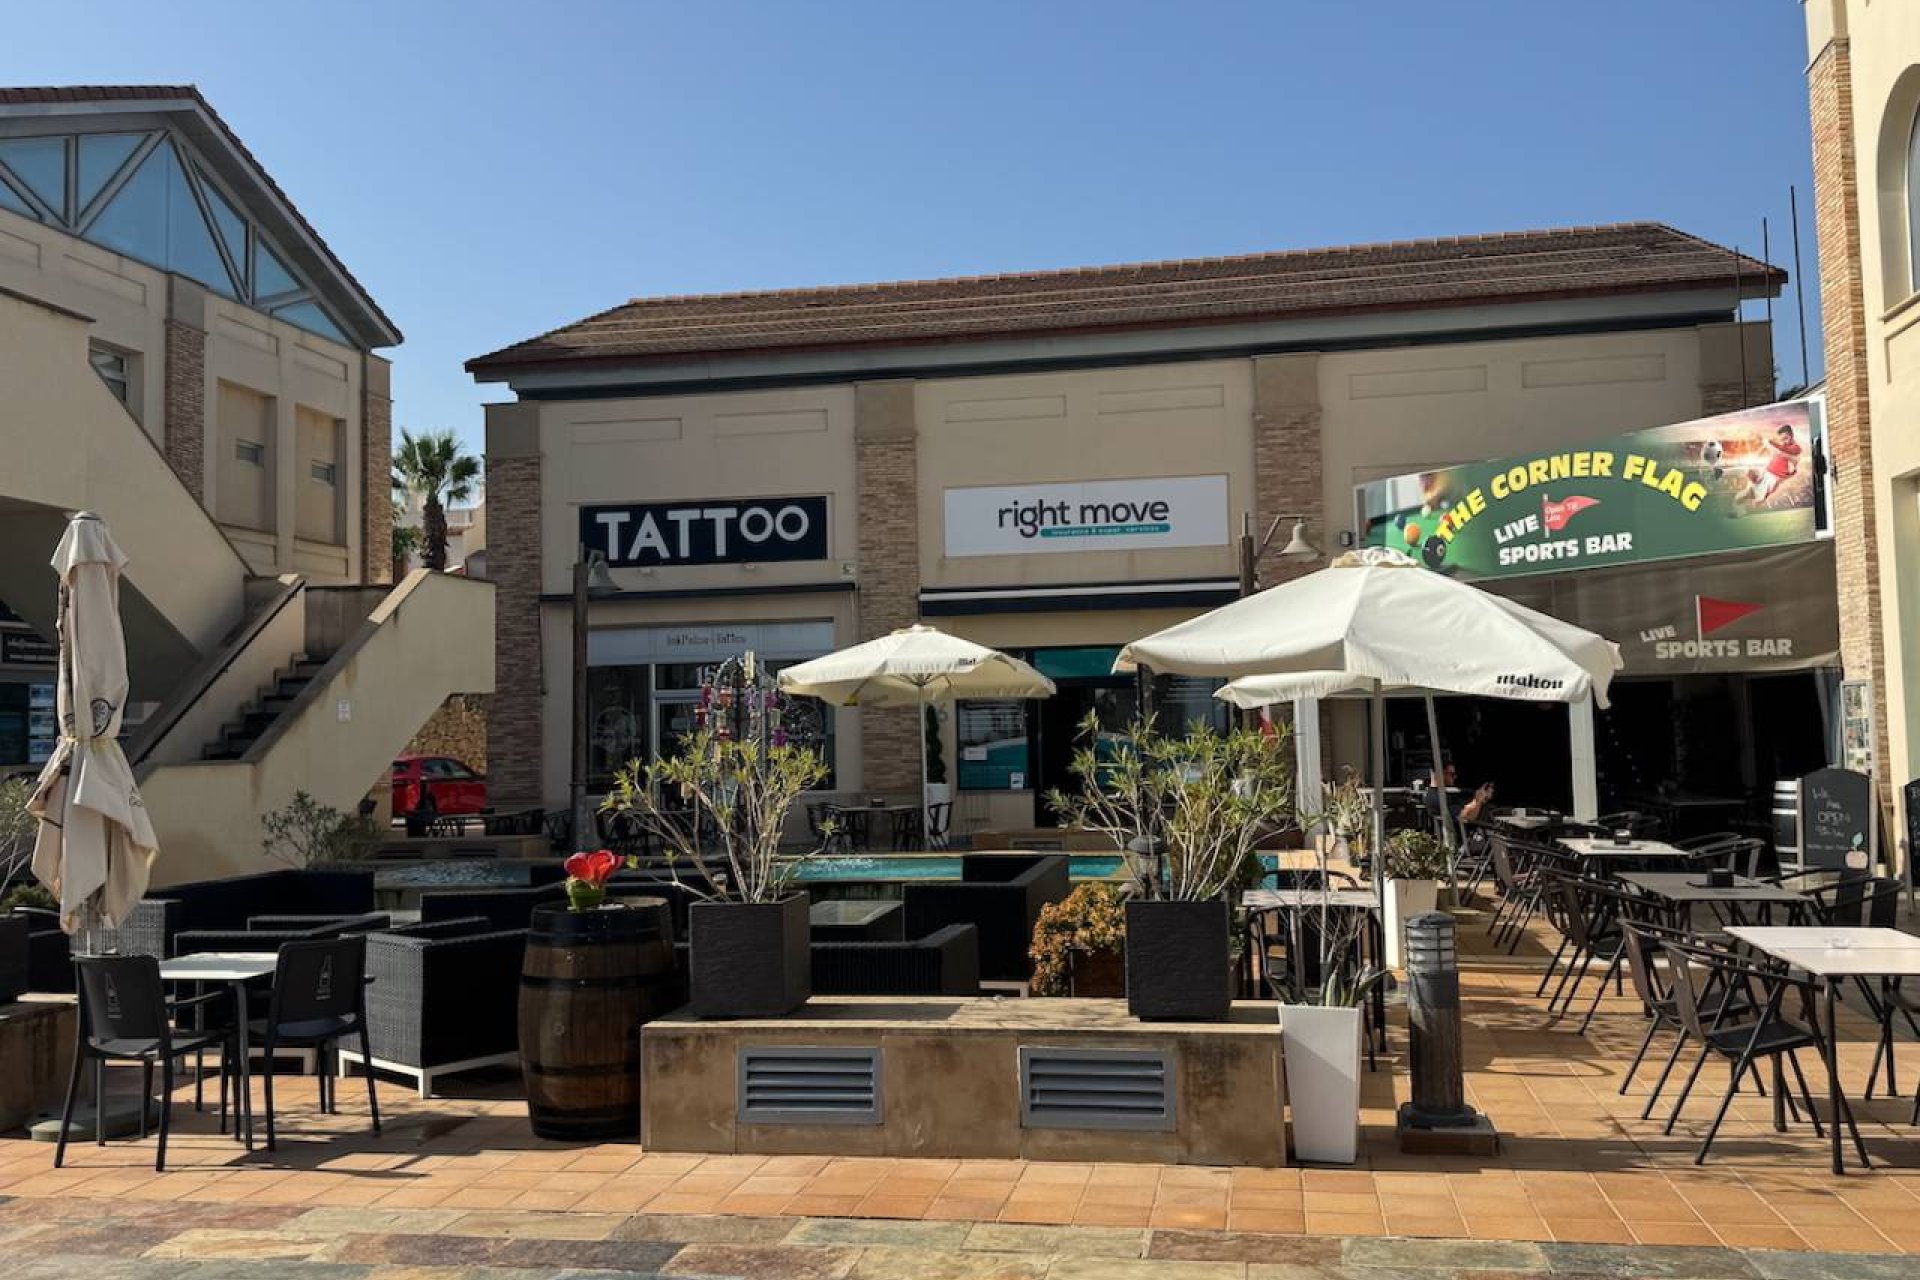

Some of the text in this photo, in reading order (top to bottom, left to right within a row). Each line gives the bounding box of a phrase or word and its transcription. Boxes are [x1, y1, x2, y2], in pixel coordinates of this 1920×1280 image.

[1437, 452, 1708, 542] THE CORNER FLAG
[595, 505, 810, 561] TATTOO
[998, 499, 1170, 538] right move
[1494, 514, 1539, 544] LIVE
[1500, 532, 1633, 566] SPORTS BAR
[1640, 625, 1677, 642] LIVE
[1655, 638, 1792, 659] SPORTS BAR
